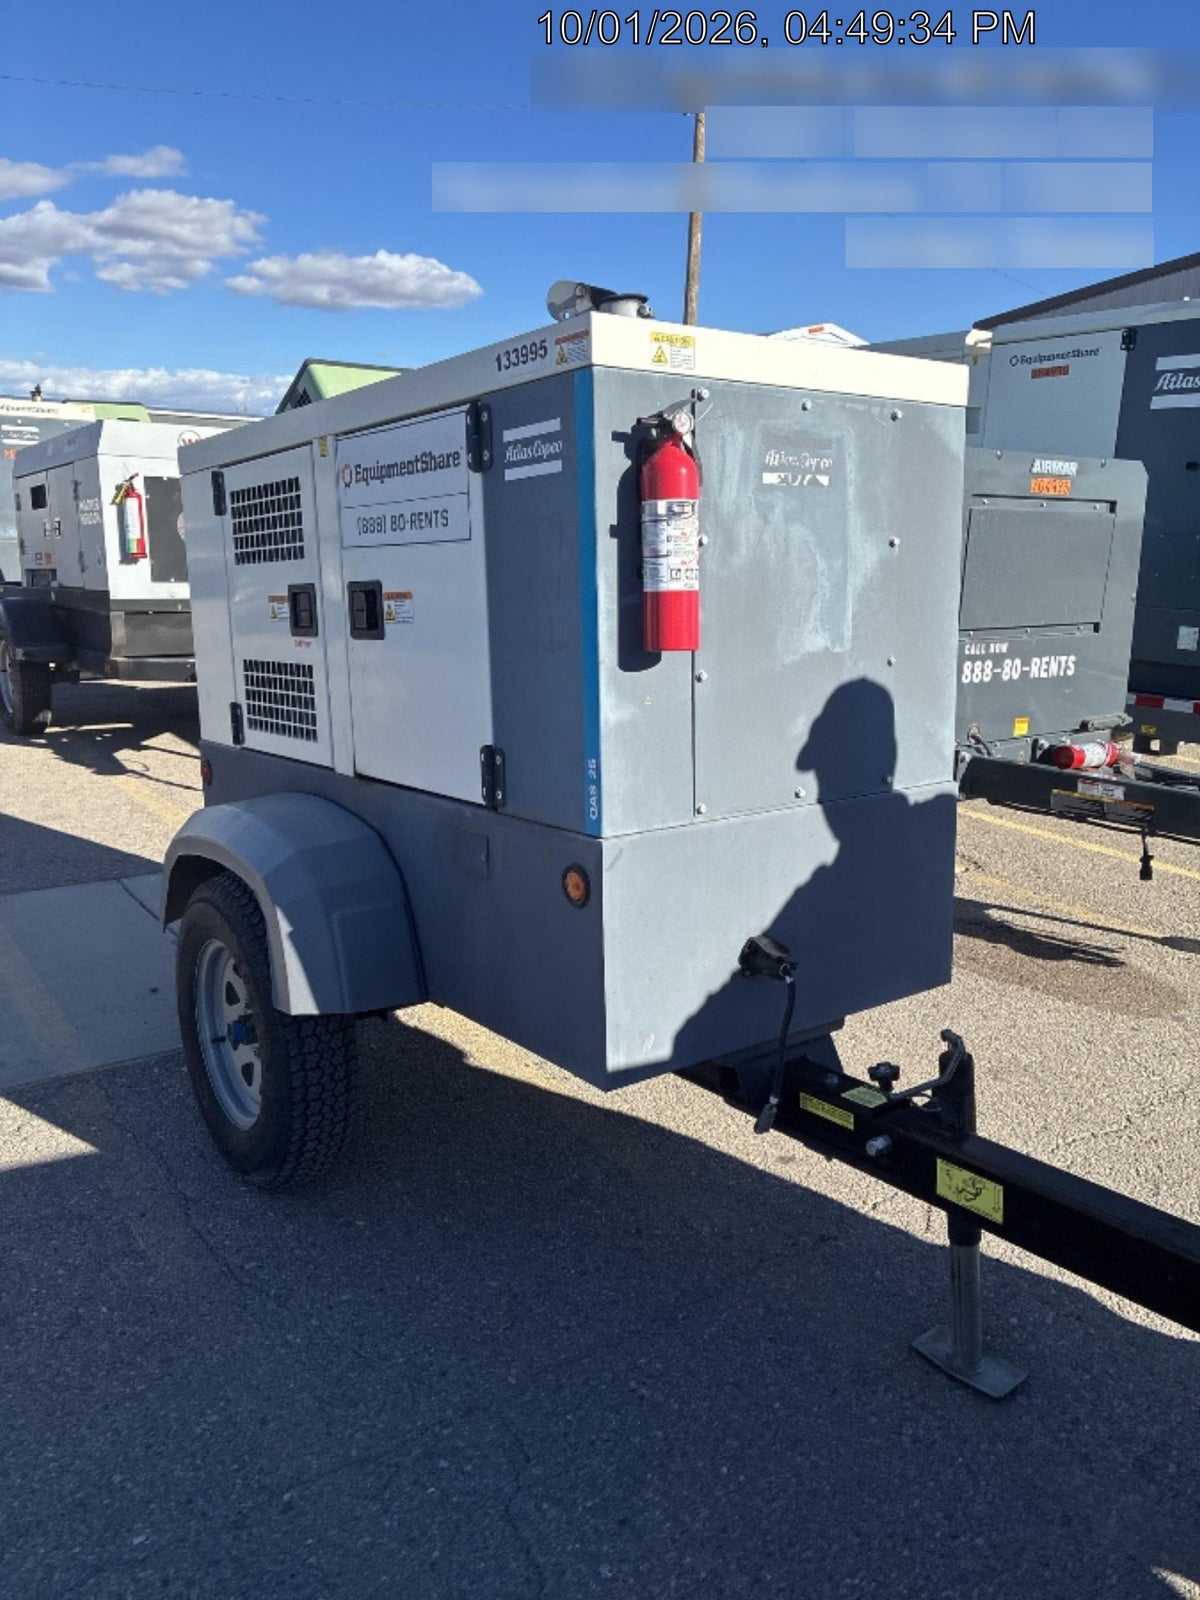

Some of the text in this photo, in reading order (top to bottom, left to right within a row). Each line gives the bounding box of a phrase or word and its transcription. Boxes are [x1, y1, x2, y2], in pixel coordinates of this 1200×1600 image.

[495, 338, 548, 372] 133995
[1153, 372, 1200, 391] Atlas
[504, 439, 563, 463] Atlas Copco
[354, 450, 461, 487] EquipmentShare
[356, 508, 449, 536] (888) 80-RENTS
[961, 654, 1077, 684] 888-80-RENTS
